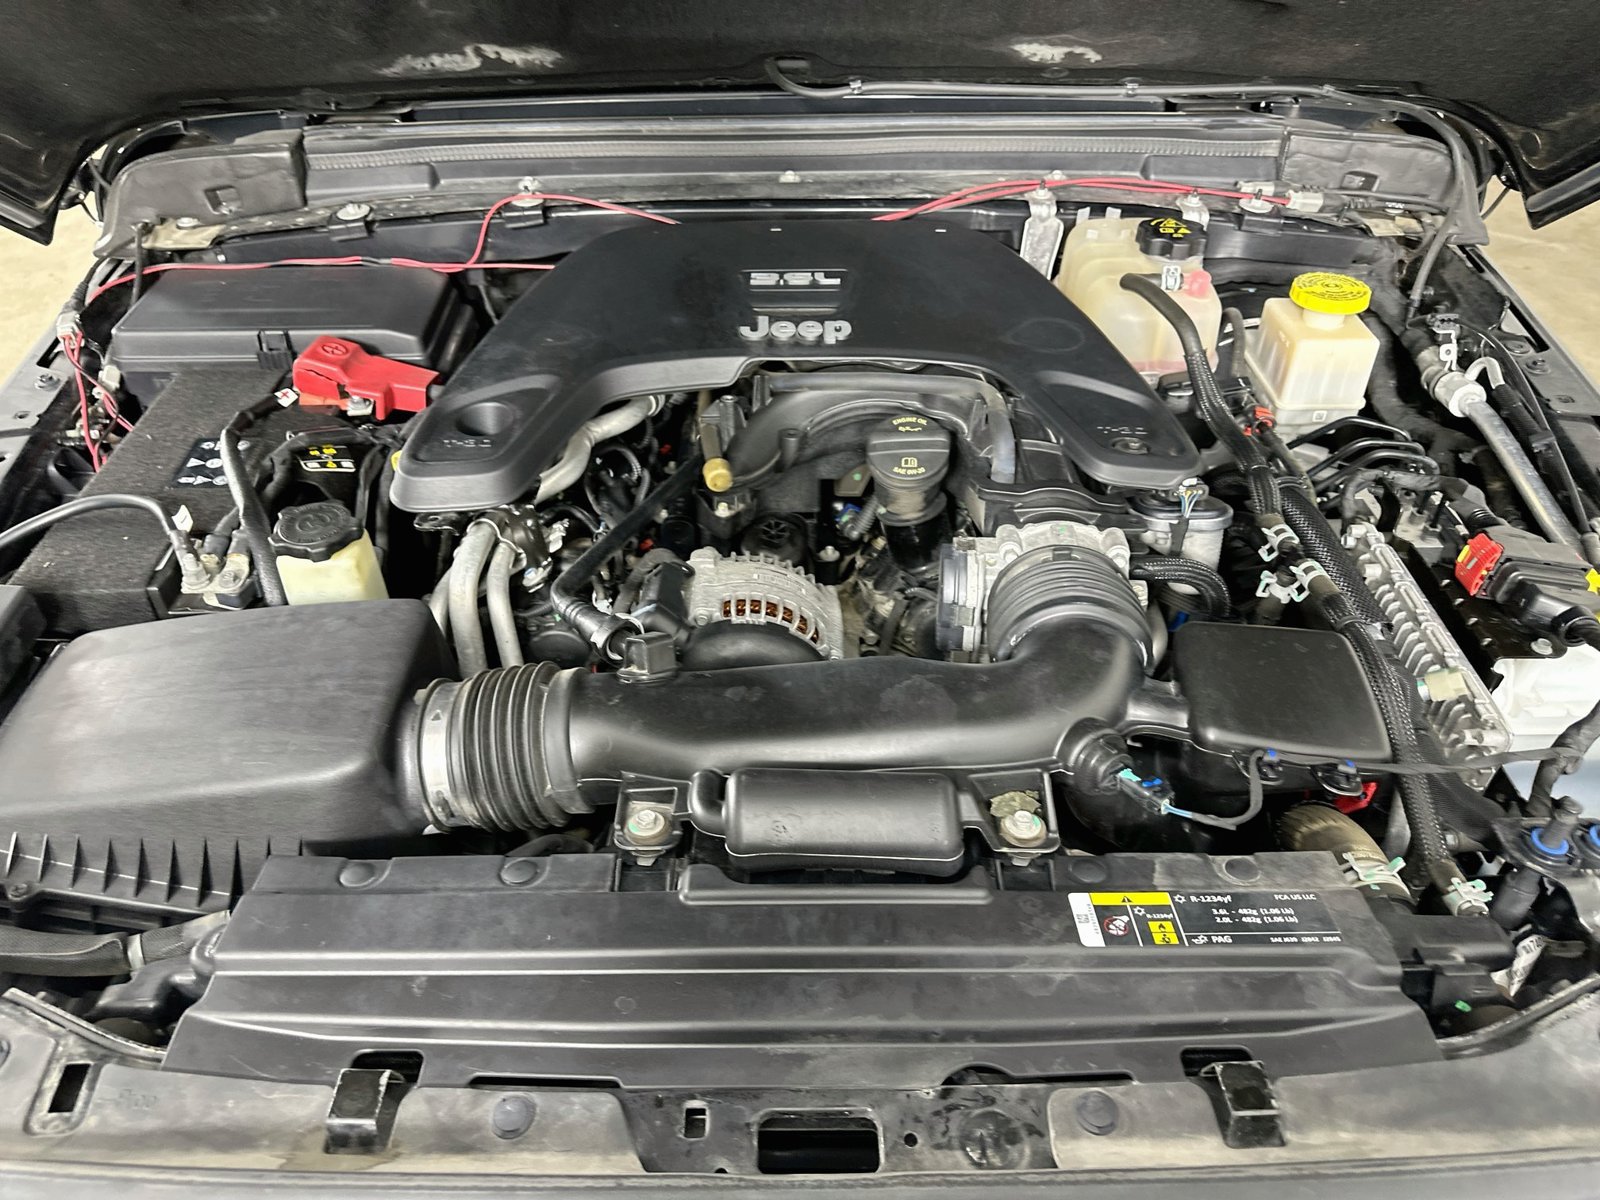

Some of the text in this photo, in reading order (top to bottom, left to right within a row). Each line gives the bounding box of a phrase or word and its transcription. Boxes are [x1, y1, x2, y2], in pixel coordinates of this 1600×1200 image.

[739, 315, 852, 344] Jeep
[892, 417, 928, 426] ENGINE OIL
[892, 466, 906, 475] SAE
[1189, 895, 1232, 904] R-1234yf
[1273, 893, 1317, 901] FCA US LLC
[1210, 935, 1233, 943] PAG
